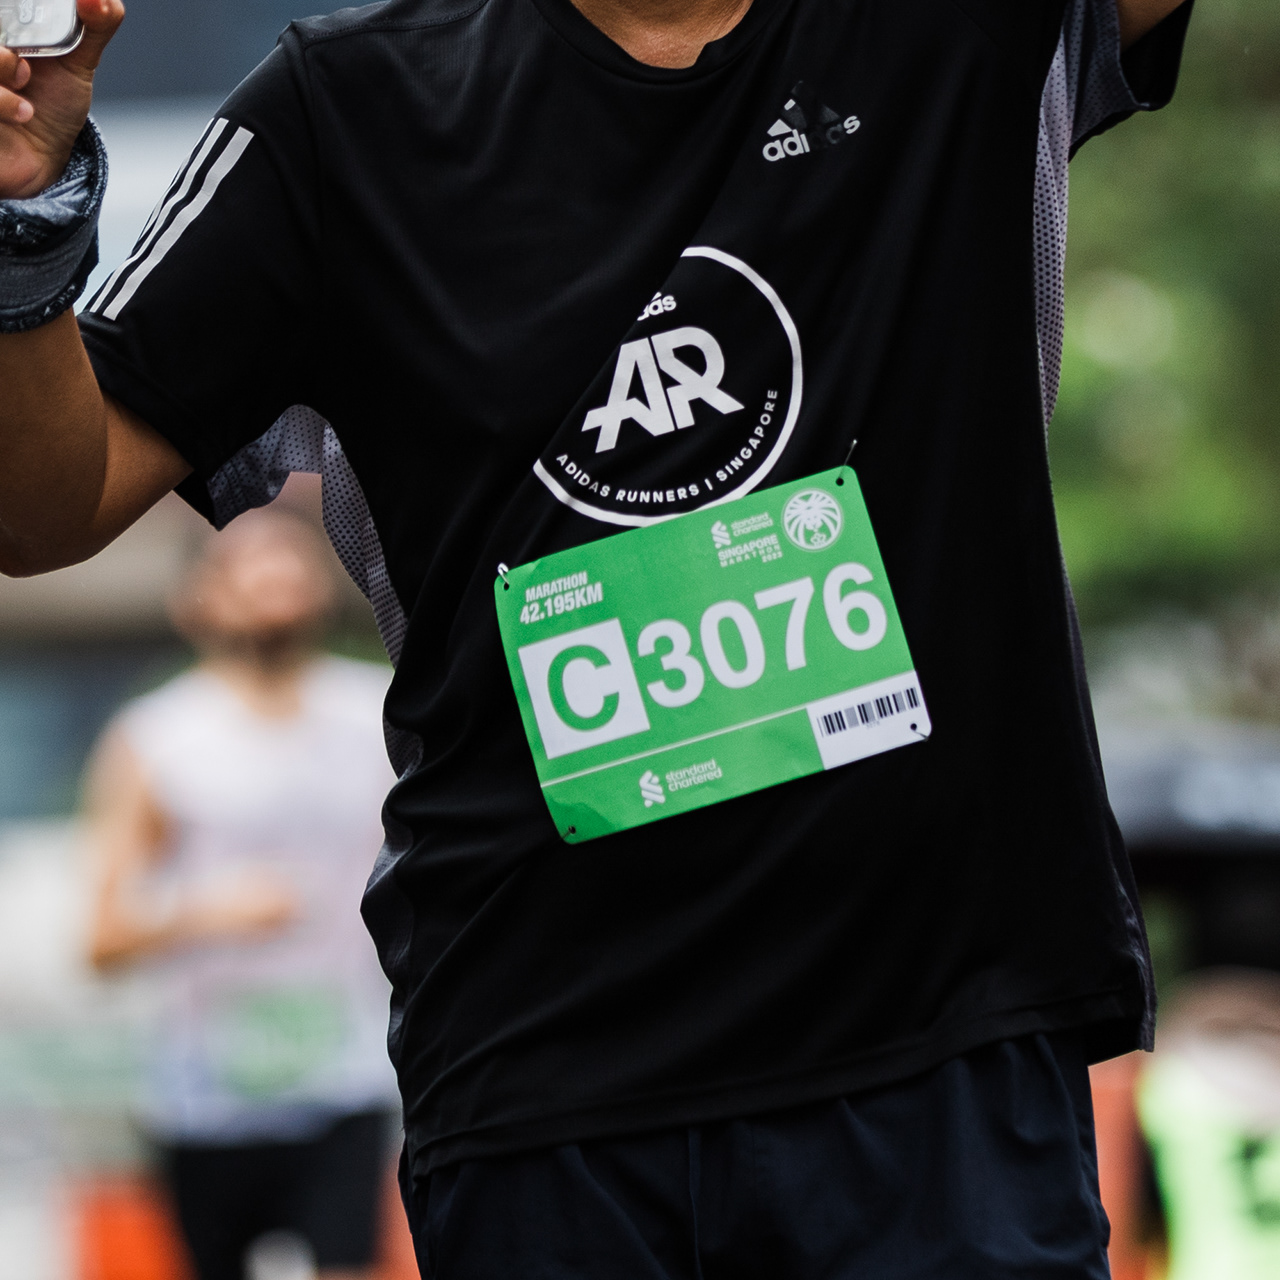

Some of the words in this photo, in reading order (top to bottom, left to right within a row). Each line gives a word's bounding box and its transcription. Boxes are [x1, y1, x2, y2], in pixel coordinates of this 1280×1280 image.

[581, 326, 745, 453] AR
[556, 454, 611, 498] ADIDAS
[616, 483, 700, 503] RUNNERS
[716, 389, 778, 483] SINGAPORE
[718, 534, 778, 561] SINGAPORE
[720, 545, 780, 567] MARATHON
[520, 581, 604, 624] 42.195KM
[525, 570, 588, 603] MARATHON
[547, 643, 620, 734] C
[636, 561, 888, 709] 3076
[665, 758, 717, 783] standard
[668, 767, 723, 793] chartered
